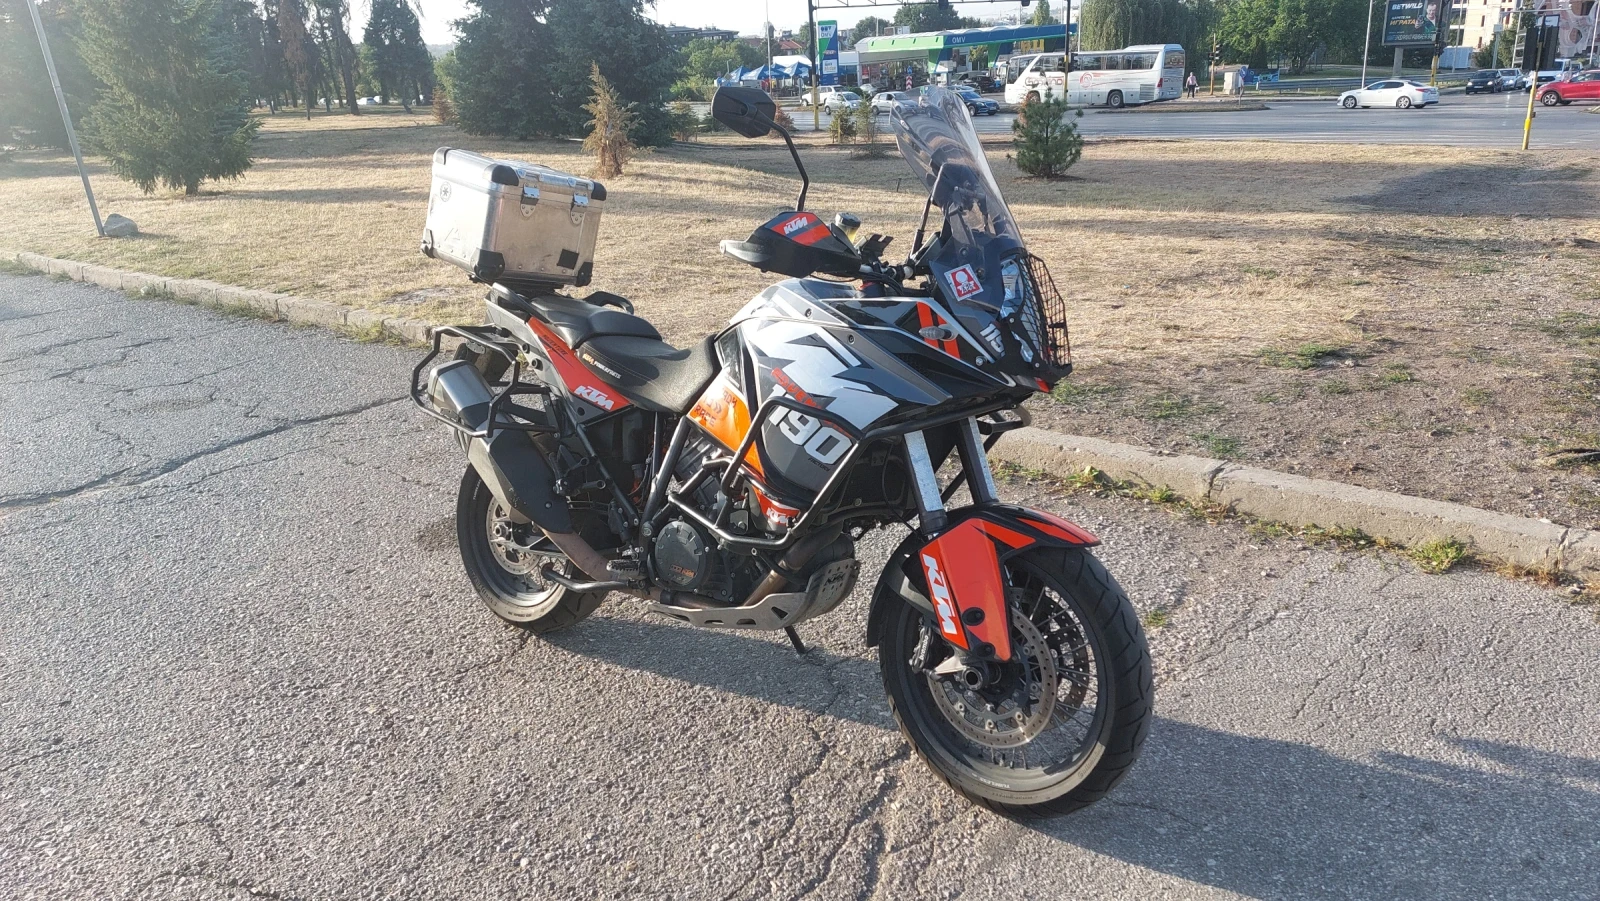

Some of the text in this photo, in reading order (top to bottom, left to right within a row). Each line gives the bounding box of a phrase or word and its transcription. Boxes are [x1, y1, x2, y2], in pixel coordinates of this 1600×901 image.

[951, 36, 966, 44] OMV
[783, 216, 808, 235] KTM
[574, 385, 615, 410] KTM
[922, 553, 958, 635] KTM
[919, 635, 929, 661] brembo
